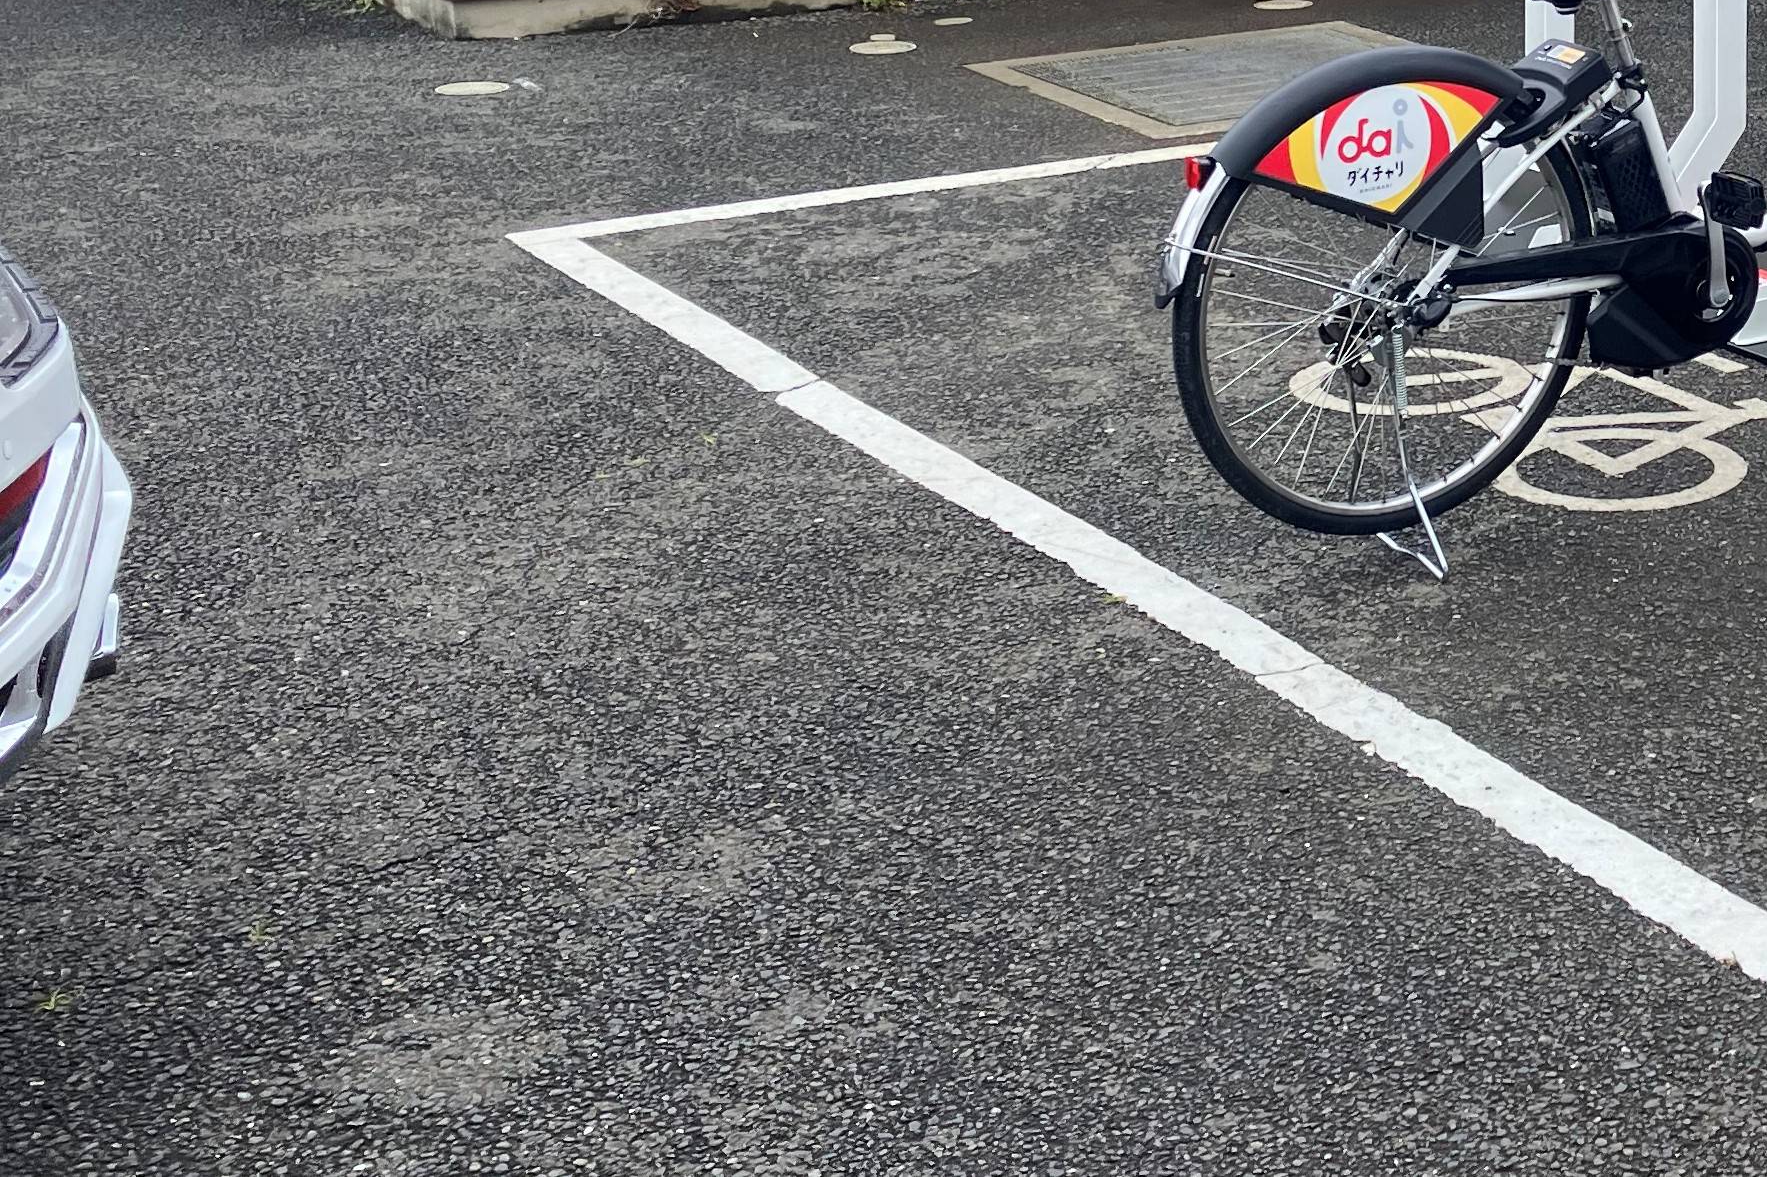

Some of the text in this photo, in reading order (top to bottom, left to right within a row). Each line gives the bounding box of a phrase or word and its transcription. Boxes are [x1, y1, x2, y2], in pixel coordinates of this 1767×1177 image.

[1347, 161, 1404, 186] ダイチャリ
